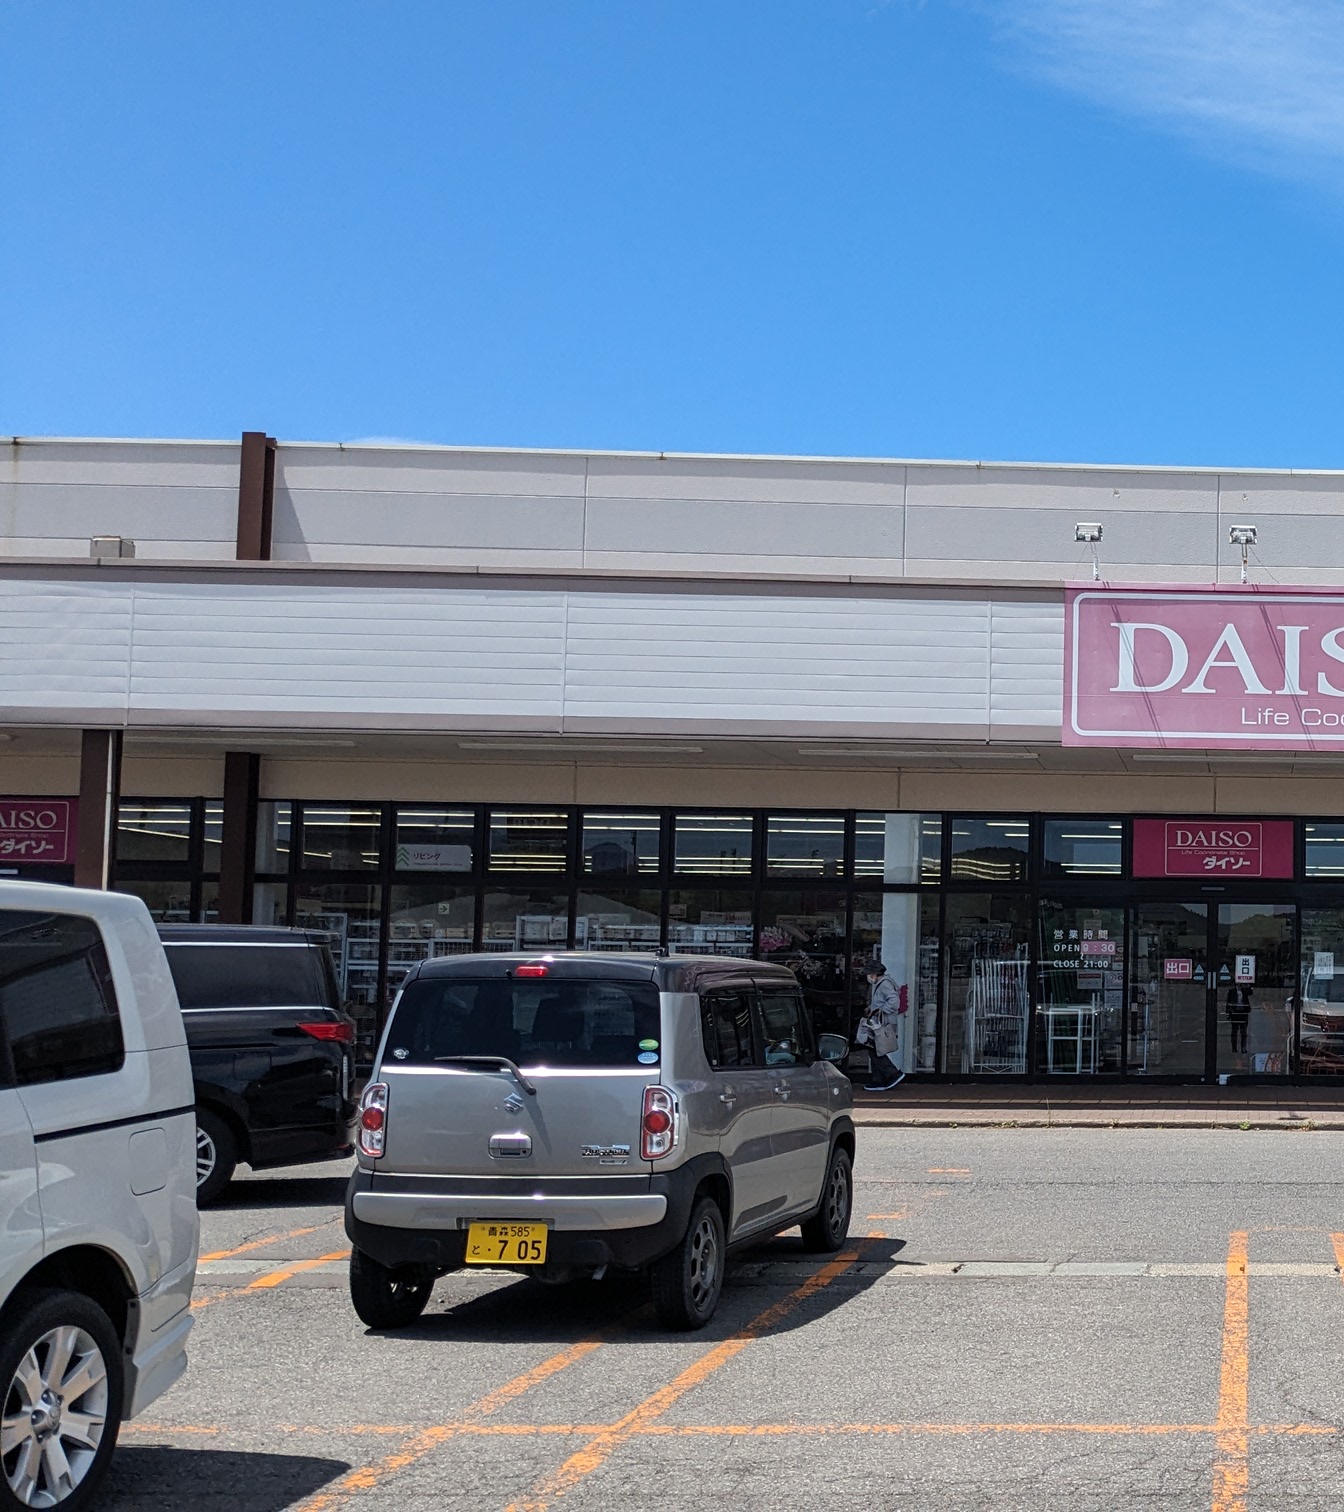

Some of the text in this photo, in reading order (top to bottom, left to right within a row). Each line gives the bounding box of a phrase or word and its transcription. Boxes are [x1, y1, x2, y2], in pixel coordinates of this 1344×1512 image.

[1240, 707, 1290, 726] Life
[1175, 830, 1252, 847] DAISO
[0, 838, 54, 854] ダイソー
[1203, 856, 1251, 869] ダイソー
[1053, 929, 1109, 940] 営業時間
[1053, 944, 1080, 952] OPEN
[1053, 960, 1109, 968] CLOSE 21:00
[1166, 962, 1190, 974] 出口
[1241, 958, 1250, 975] 出口
